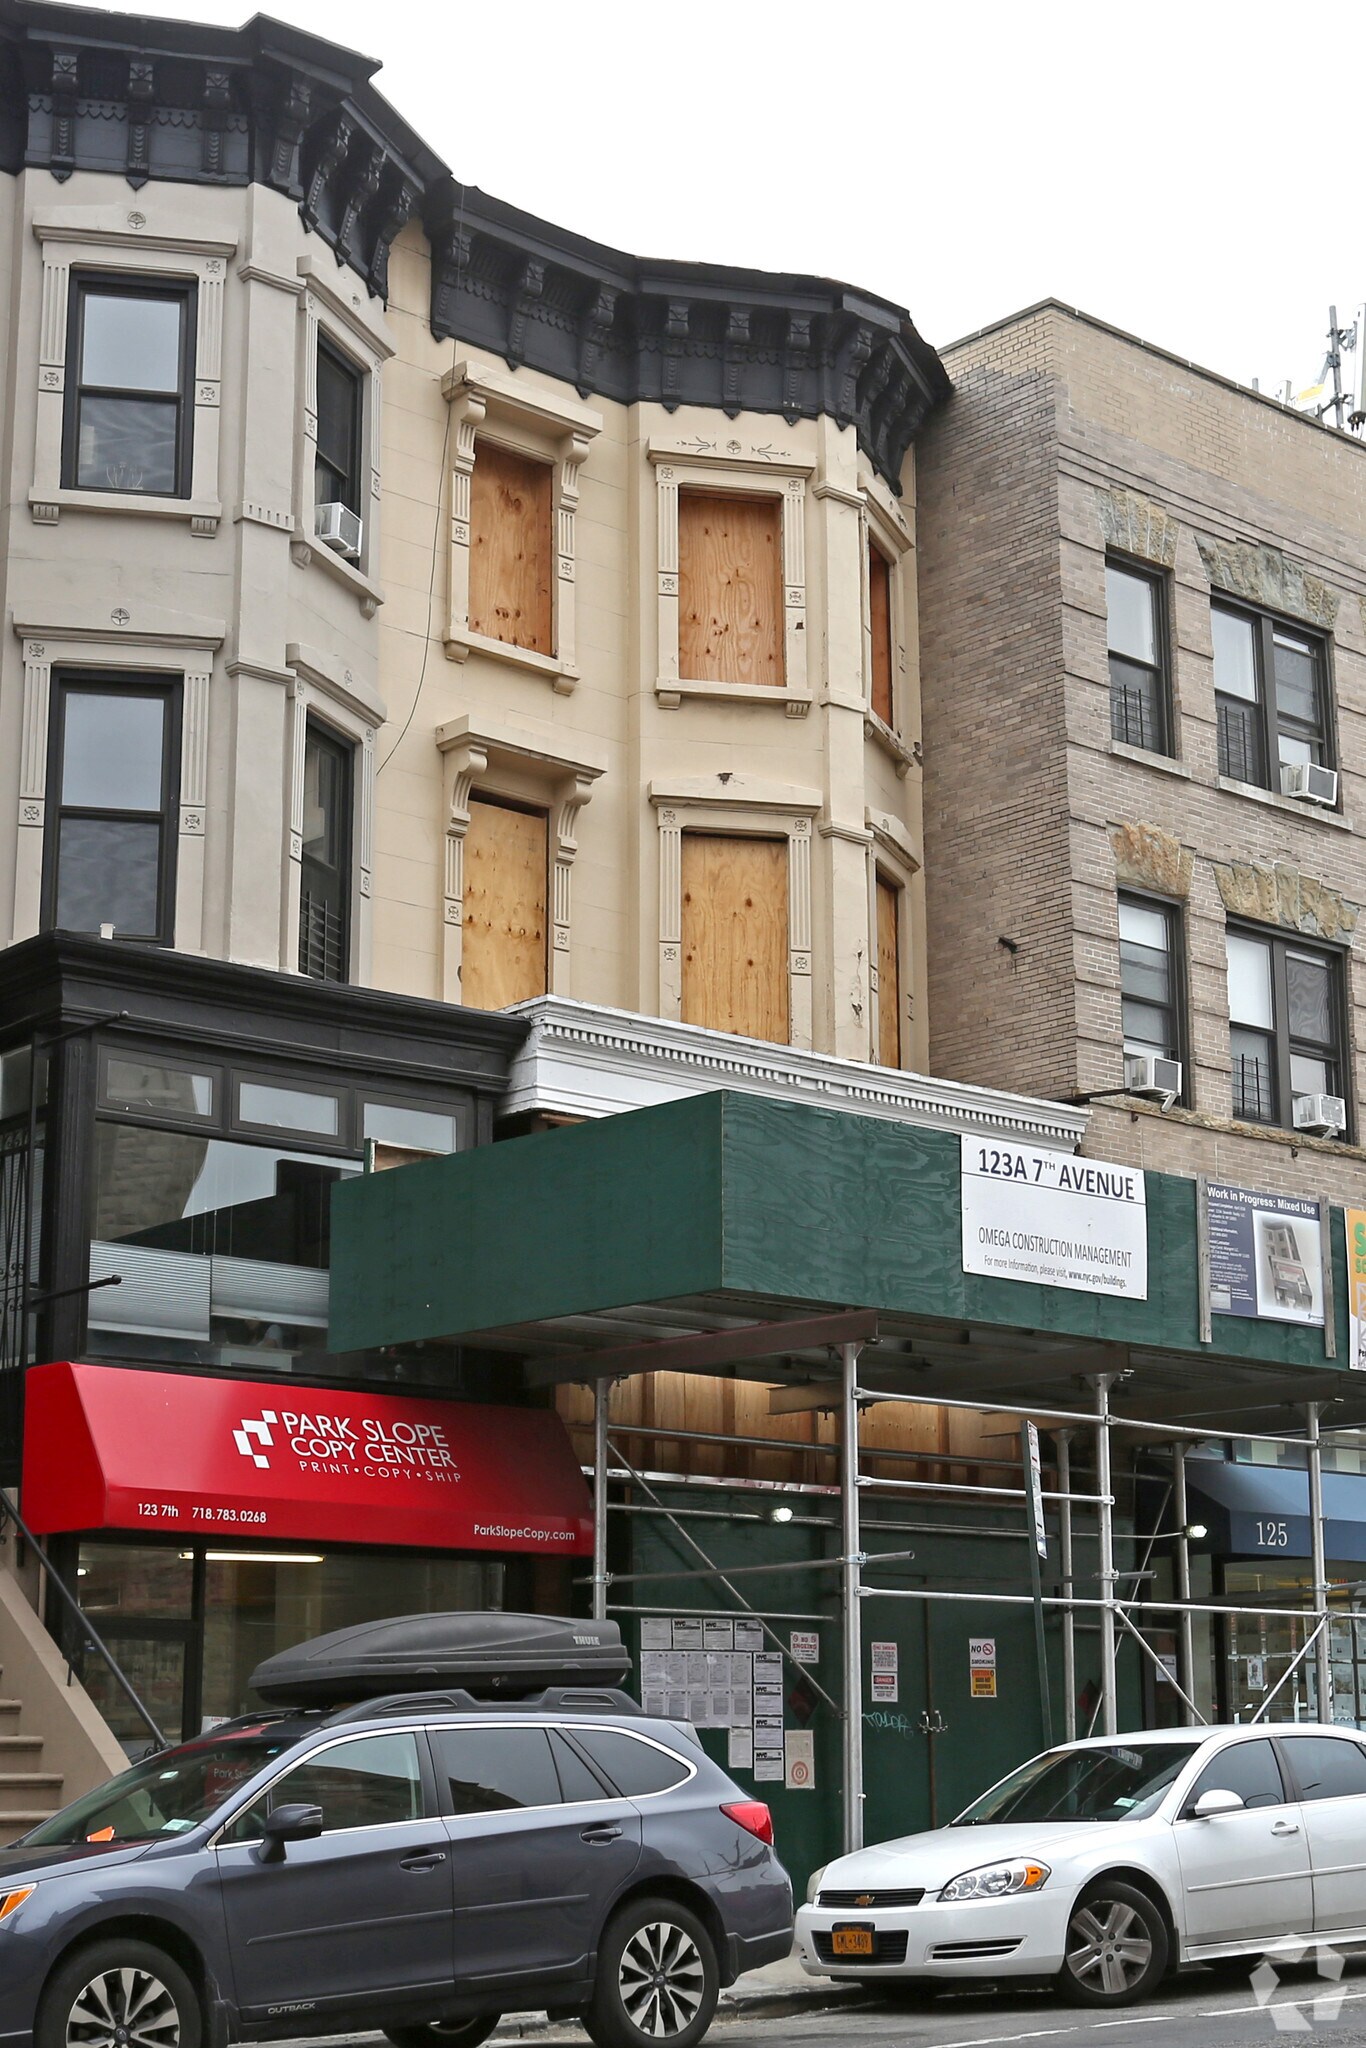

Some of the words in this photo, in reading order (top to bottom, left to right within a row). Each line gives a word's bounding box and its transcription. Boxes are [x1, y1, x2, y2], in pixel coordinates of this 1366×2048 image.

[979, 1148, 1028, 1180] 123A
[1059, 1164, 1135, 1200] AVENUE
[1207, 1186, 1229, 1199] Work
[1230, 1190, 1238, 1200] in
[1239, 1192, 1276, 1208] Progress:
[1277, 1198, 1300, 1212] Mixed
[1301, 1203, 1316, 1215] Use
[978, 1226, 1011, 1248] OMEGA
[1012, 1232, 1073, 1259] CONSTRUCTION
[1074, 1243, 1132, 1268] MANAGEMENT
[984, 1255, 993, 1265] For
[994, 1259, 1008, 1268] more
[1008, 1259, 1039, 1275] Information,
[1039, 1264, 1056, 1276] please
[1056, 1267, 1068, 1279] visit,
[281, 1411, 360, 1440] PARK
[362, 1419, 449, 1448] SLOPE
[290, 1437, 356, 1461] COPY
[364, 1443, 458, 1469] CENTER
[138, 1503, 158, 1516] 123
[161, 1505, 179, 1518] 7th
[192, 1507, 267, 1524] 718.783.0268
[474, 1524, 575, 1541] ParkSlopeCopy.com
[1256, 1521, 1288, 1547] 125
[573, 1635, 600, 1646] THULE
[971, 1645, 982, 1653] NO
[267, 2002, 316, 2014] OUTBACK
